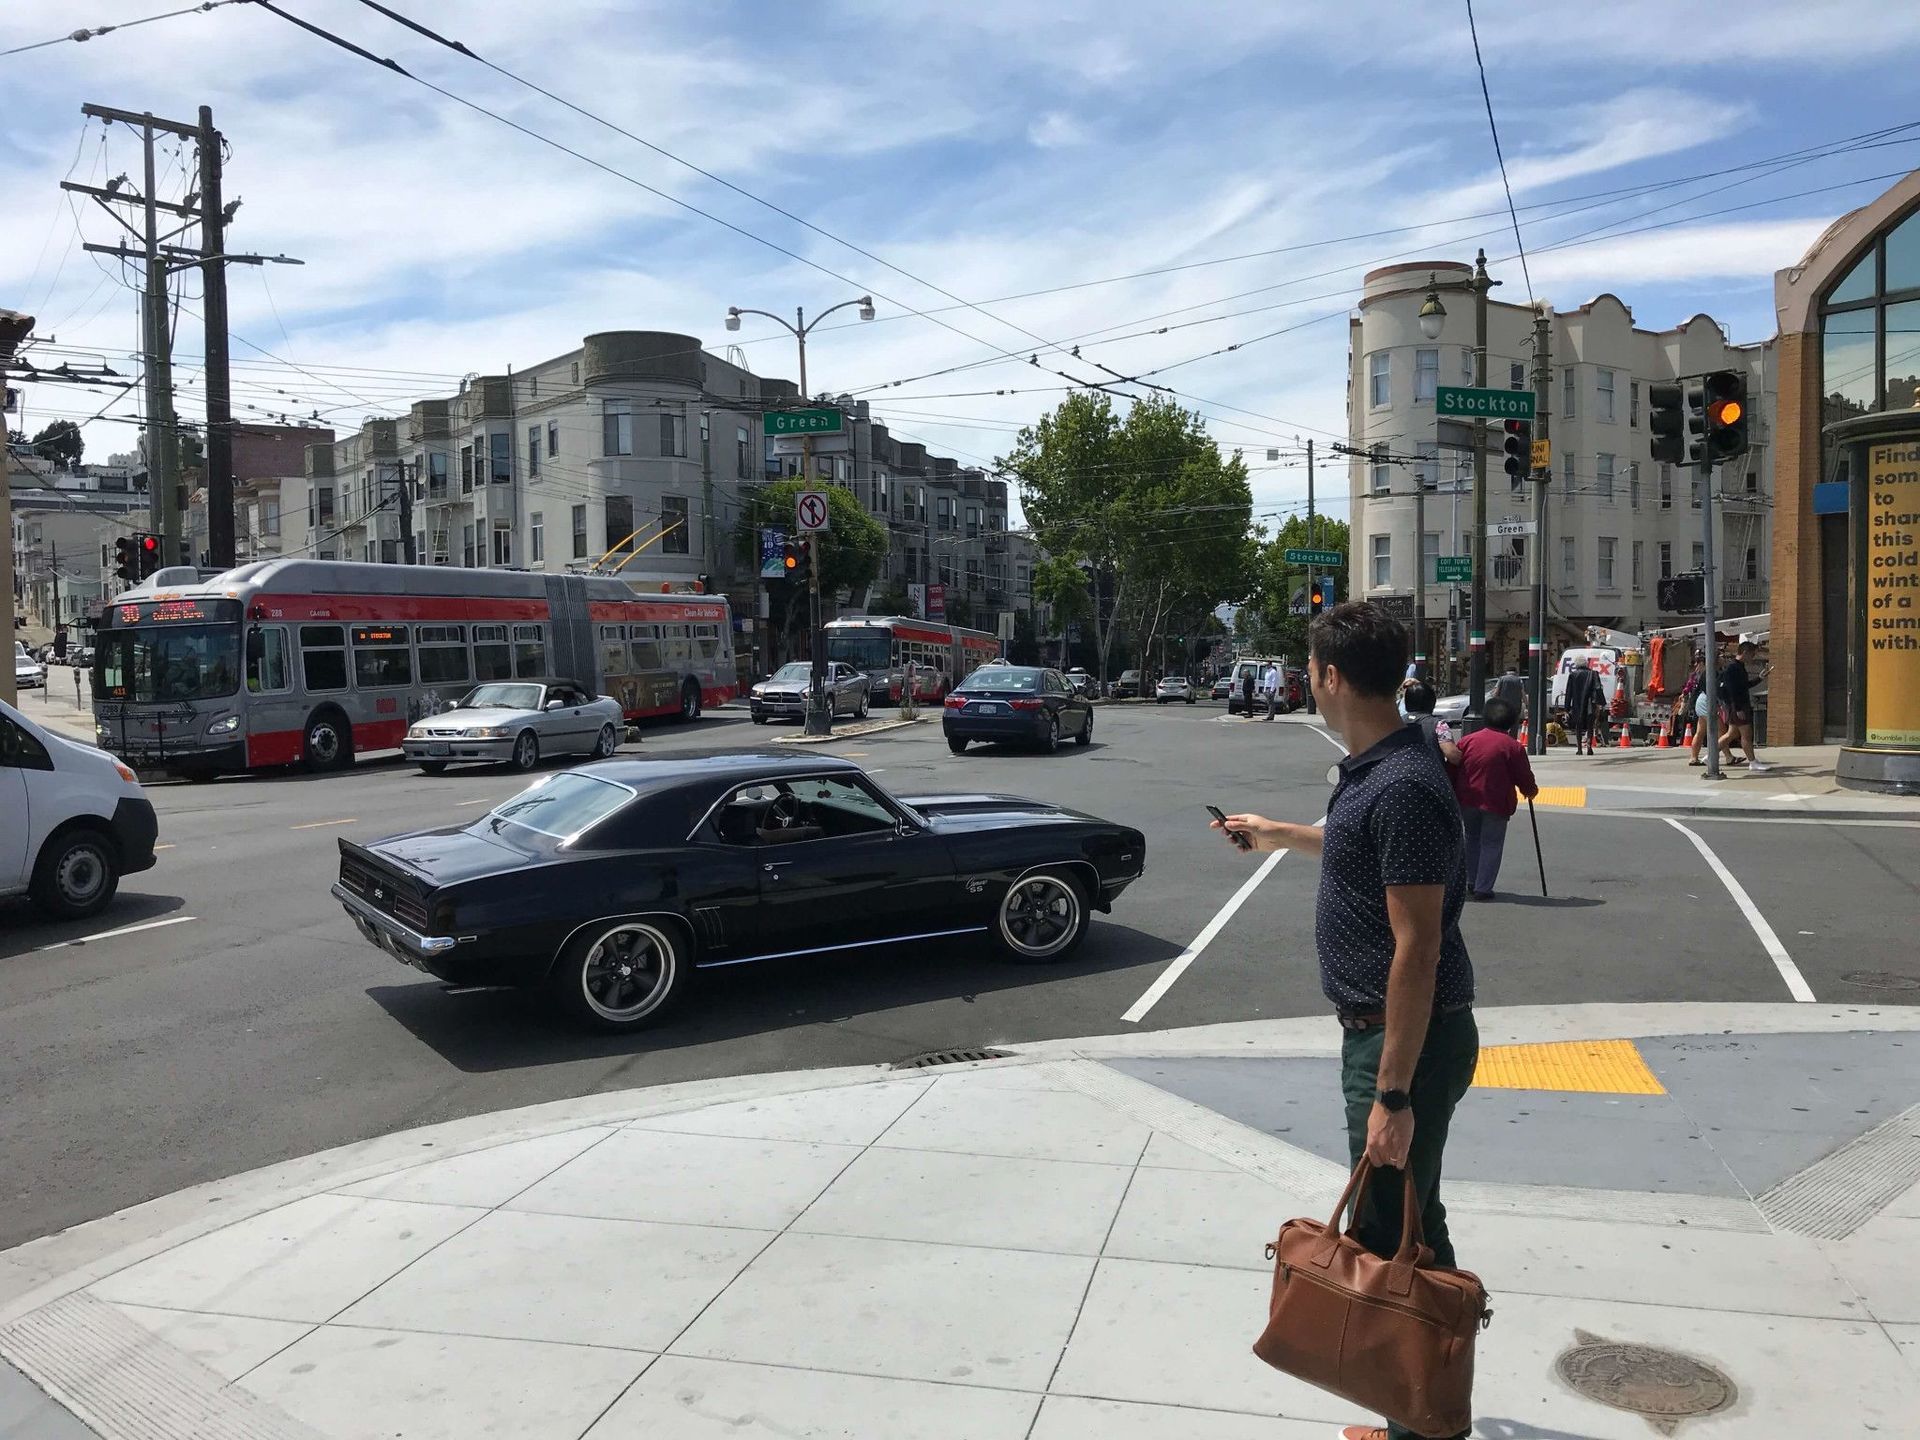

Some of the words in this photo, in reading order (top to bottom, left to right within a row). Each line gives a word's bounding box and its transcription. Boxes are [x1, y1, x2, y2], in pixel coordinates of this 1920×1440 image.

[1444, 393, 1528, 413] Stockton
[776, 416, 828, 430] Green
[1875, 446, 1920, 464] Find
[1874, 492, 1894, 506] to
[1497, 525, 1524, 534] Green
[1873, 531, 1913, 547] this
[1289, 552, 1338, 563] Stockton
[1873, 551, 1918, 568] cold
[1873, 572, 1919, 588] wint
[1872, 593, 1892, 608] of
[1898, 596, 1911, 608] a
[684, 607, 697, 617] Clean
[704, 607, 719, 617] Vehicle
[1562, 657, 1609, 675] FeEx
[970, 885, 984, 893] SS
